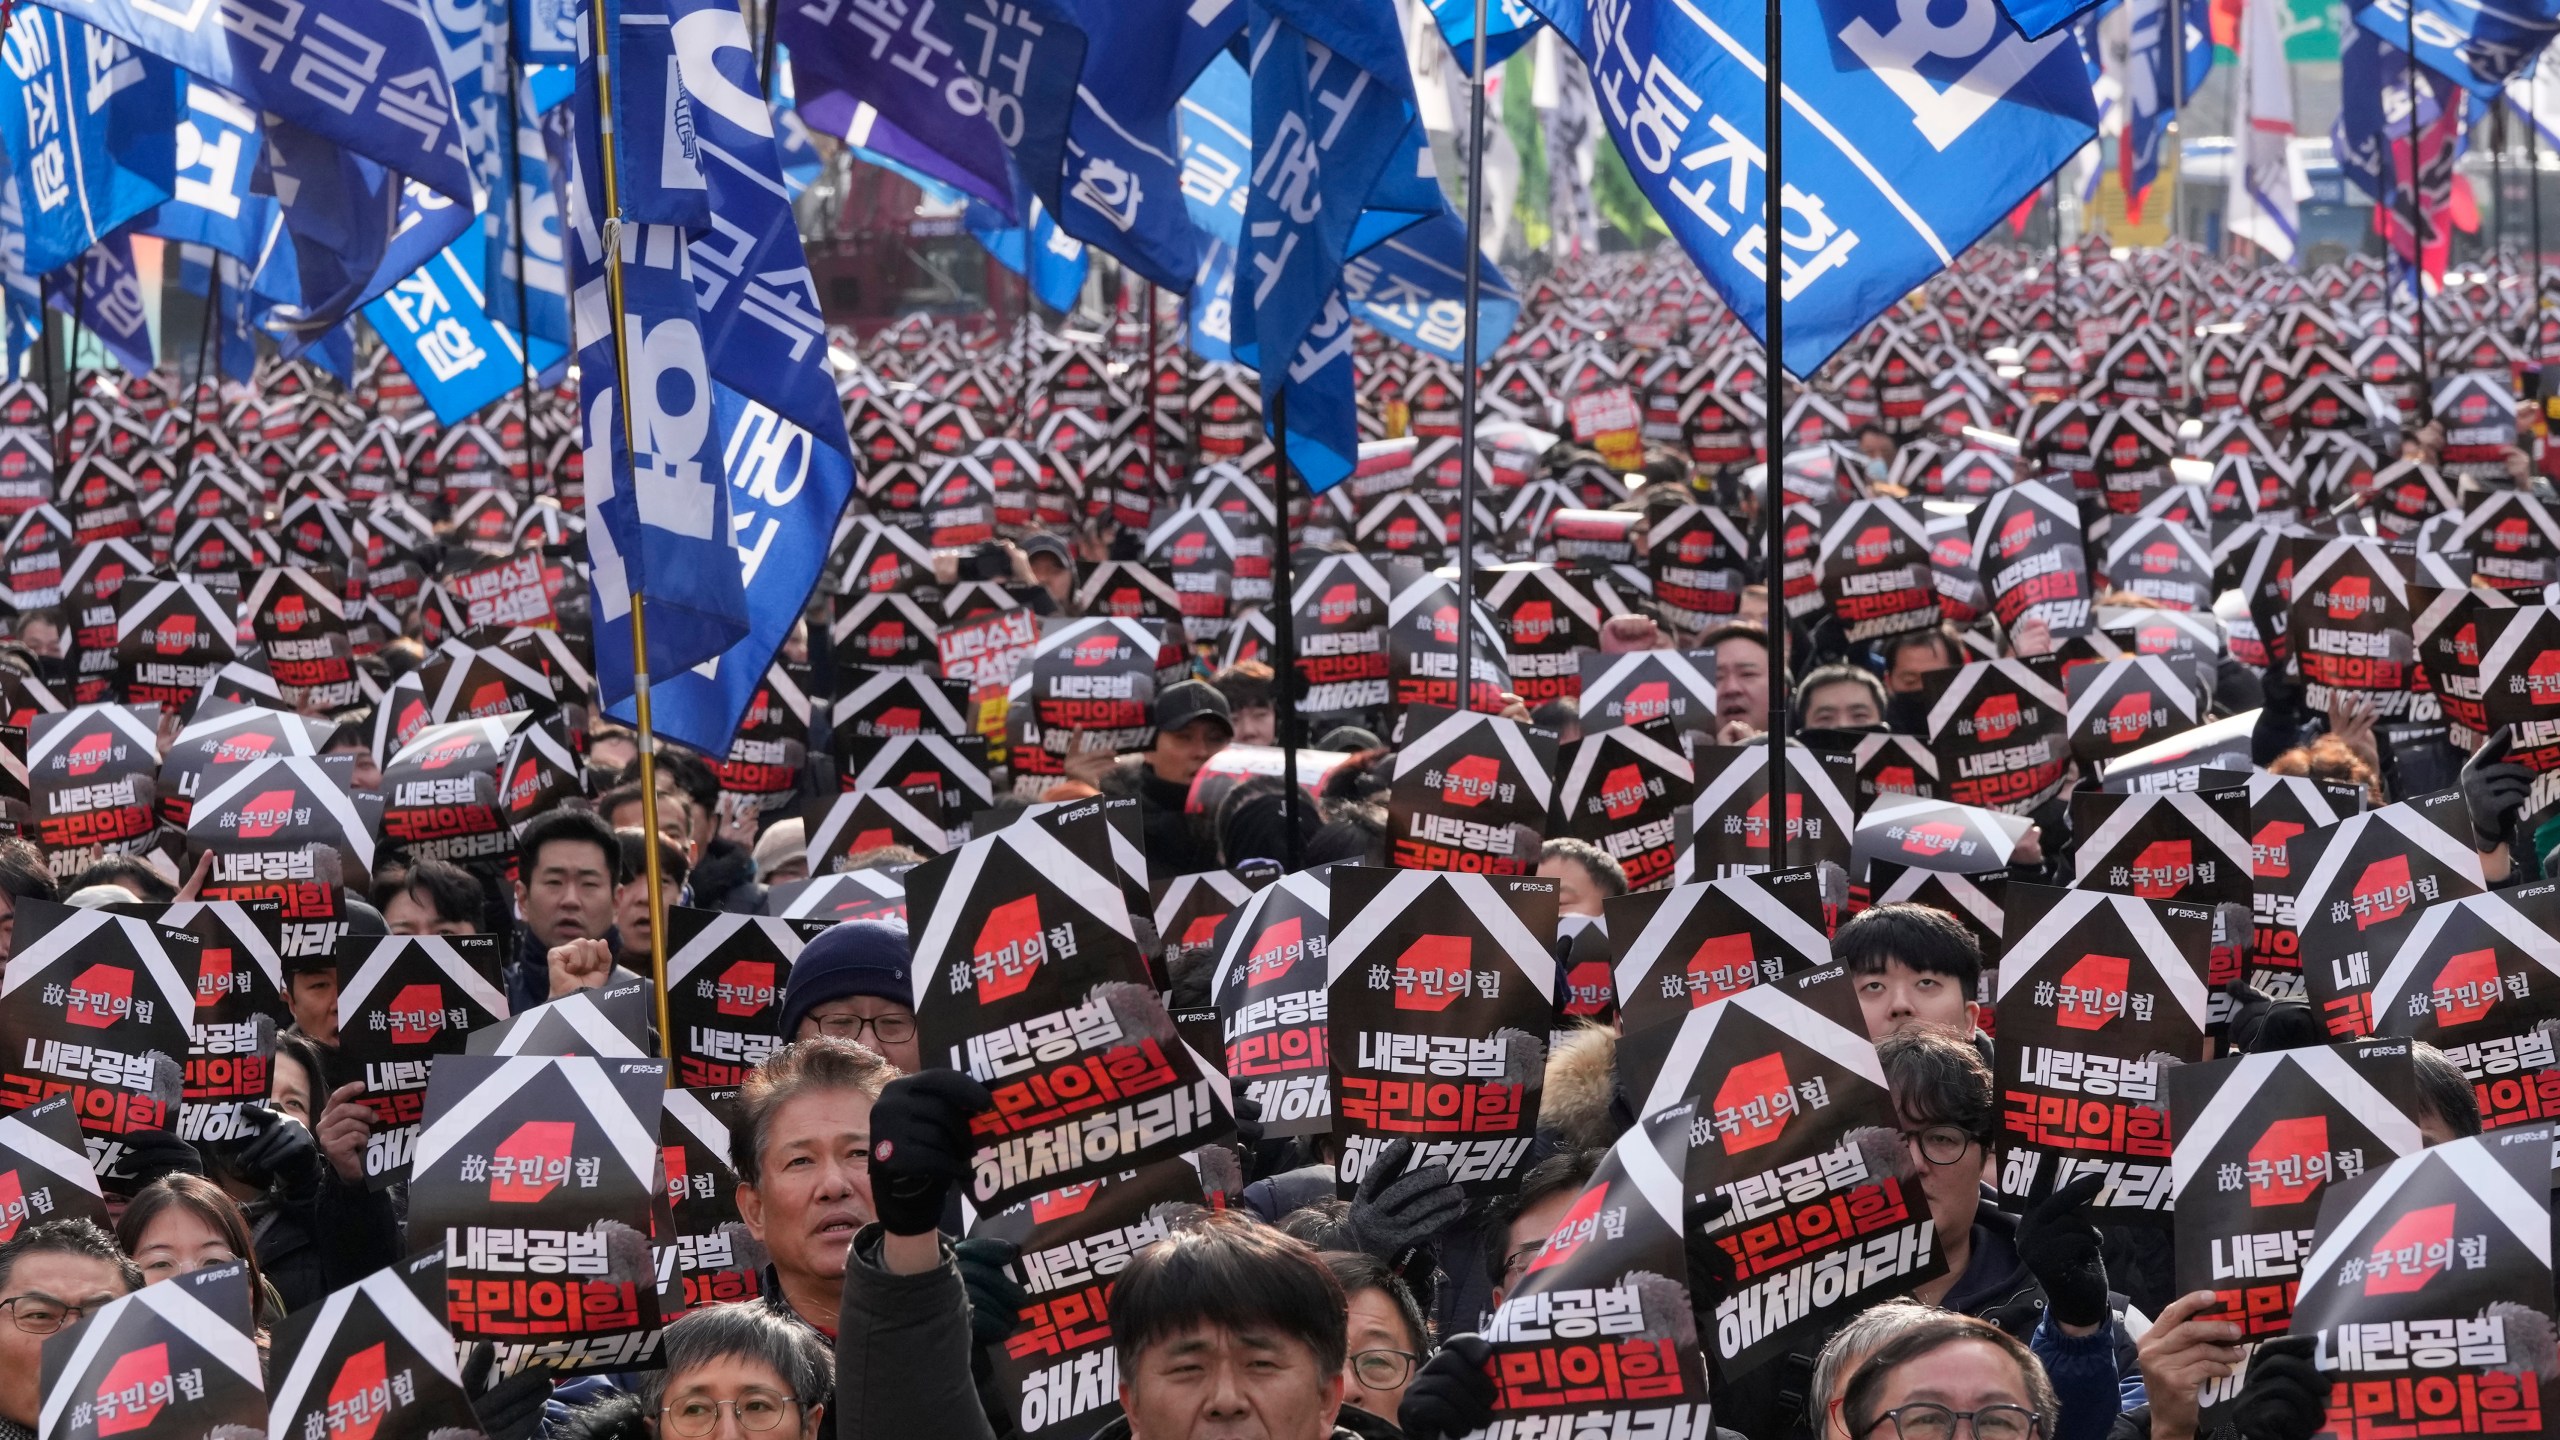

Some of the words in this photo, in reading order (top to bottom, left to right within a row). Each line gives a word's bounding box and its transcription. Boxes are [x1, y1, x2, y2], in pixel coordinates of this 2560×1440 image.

[459, 550, 541, 601] 내란수괴
[1661, 566, 1730, 590] 내란공범
[1840, 564, 1916, 596] 내란공범
[1991, 548, 2063, 592] 내란공범
[2476, 556, 2544, 580] 내란공범
[1835, 586, 1930, 620] 국민의힘
[2124, 579, 2196, 602] 내란공범
[2313, 590, 2387, 614] 故국민의힘
[82, 604, 117, 626] 내란
[78, 624, 118, 648] 국민
[140, 626, 211, 649] 故국민의힘
[268, 637, 334, 659] 내란공범
[943, 608, 1035, 663] 내란수괴
[1300, 631, 1380, 655] 내란공범
[2308, 627, 2391, 658] 내란공범
[1058, 646, 1132, 661] 故국민의힘
[2300, 651, 2402, 688] 국민의힘
[270, 657, 350, 686] 국민의힘
[1049, 675, 1133, 699] 내란공범
[2509, 672, 2560, 695] 故국민
[1039, 700, 1146, 726] 국민의힘
[1606, 698, 1686, 717] 故국민의힘
[1957, 707, 2039, 736] 故국민의힘
[2092, 708, 2168, 734] 故국민의힘
[2510, 720, 2560, 750] 내란
[52, 745, 128, 771] 故국민의힘
[1958, 744, 2051, 778] 내란공범
[49, 780, 136, 815] 내란공범
[395, 775, 476, 807] 내란공범
[1424, 768, 1517, 804] 故국민의힘
[1587, 776, 1667, 815] 故국민의힘
[2224, 791, 2246, 800] 민주노총
[2434, 791, 2461, 805] 민주노총
[39, 806, 154, 847] 국민의힘
[219, 806, 312, 829] 故국민의힘
[384, 806, 498, 843] 국민의힘
[1068, 802, 1100, 821] 민주노총
[1410, 811, 1518, 854] 내란공범
[1887, 825, 1978, 856] 故국민의힘
[213, 849, 314, 882] 내란공범
[1782, 872, 1812, 884] 민주노총
[2109, 861, 2216, 888] 故국민의힘
[1522, 883, 1554, 892] 민주노총
[2330, 874, 2440, 924] 故국민의힘
[2528, 884, 2556, 896] 민주노총
[2178, 909, 2209, 919] 민주노총
[175, 931, 200, 942] 민주노총
[281, 921, 349, 956] 하라!
[949, 922, 1078, 995] 故국민의힘
[1231, 934, 1328, 988] 故국민의힘
[1810, 966, 1844, 984] 민주노총
[198, 970, 252, 996] 민의힘
[614, 984, 642, 997] 민주노총
[1368, 964, 1501, 999] 故국민의힘
[1660, 956, 1784, 1000] 故국민의힘
[2407, 972, 2530, 1017] 故국민의힘
[42, 982, 154, 1026] 故국민의힘
[1188, 1012, 1216, 1022] 민주노총
[1224, 988, 1329, 1039] 내란공범
[2034, 980, 2155, 1023] 故국민의힘
[368, 1007, 470, 1032] 故국민의힘
[950, 996, 1125, 1084] 내란공범
[1224, 1028, 1330, 1076] 국민의
[1357, 1030, 1507, 1077] 내란공범
[2372, 1044, 2407, 1056] 민주노총
[2447, 1029, 2556, 1079] 란공범
[23, 1038, 155, 1093] 내란공범
[184, 1056, 267, 1098] 민의힘
[366, 1061, 432, 1092] 내란
[632, 1064, 664, 1074] 민주노총
[2019, 1045, 2160, 1101] 내란공범
[41, 1098, 68, 1114] 민주노총
[354, 1098, 424, 1124] 국민
[1340, 1076, 1525, 1133] 국민의힘
[1687, 1076, 1831, 1148] 故국민의힘
[2003, 1089, 2172, 1158] 국민의힘
[2512, 1130, 2549, 1144] 민주노총
[971, 1079, 1211, 1202] 해체하라!
[460, 1154, 601, 1188] 故국민의힘
[2216, 1148, 2365, 1192] 故국민의힘
[1537, 1206, 1627, 1257] 민의힘
[446, 1226, 608, 1275] 내란공범
[677, 1231, 733, 1269] 공범
[1400, 1246, 1417, 1267] Safety
[2211, 1229, 2316, 1280] 내란
[2338, 1234, 2488, 1287] 故국민의힘
[207, 1266, 240, 1281] 민주노총
[1714, 1218, 1934, 1360] 해체하라!
[448, 1278, 639, 1335] 국민의힘
[1004, 1281, 1117, 1360] 국민
[2314, 1316, 2508, 1373] 내란공범
[70, 1368, 205, 1431] 故국민의힘
[304, 1369, 416, 1440] 故국민의힘
[1020, 1345, 1120, 1433] 해체
